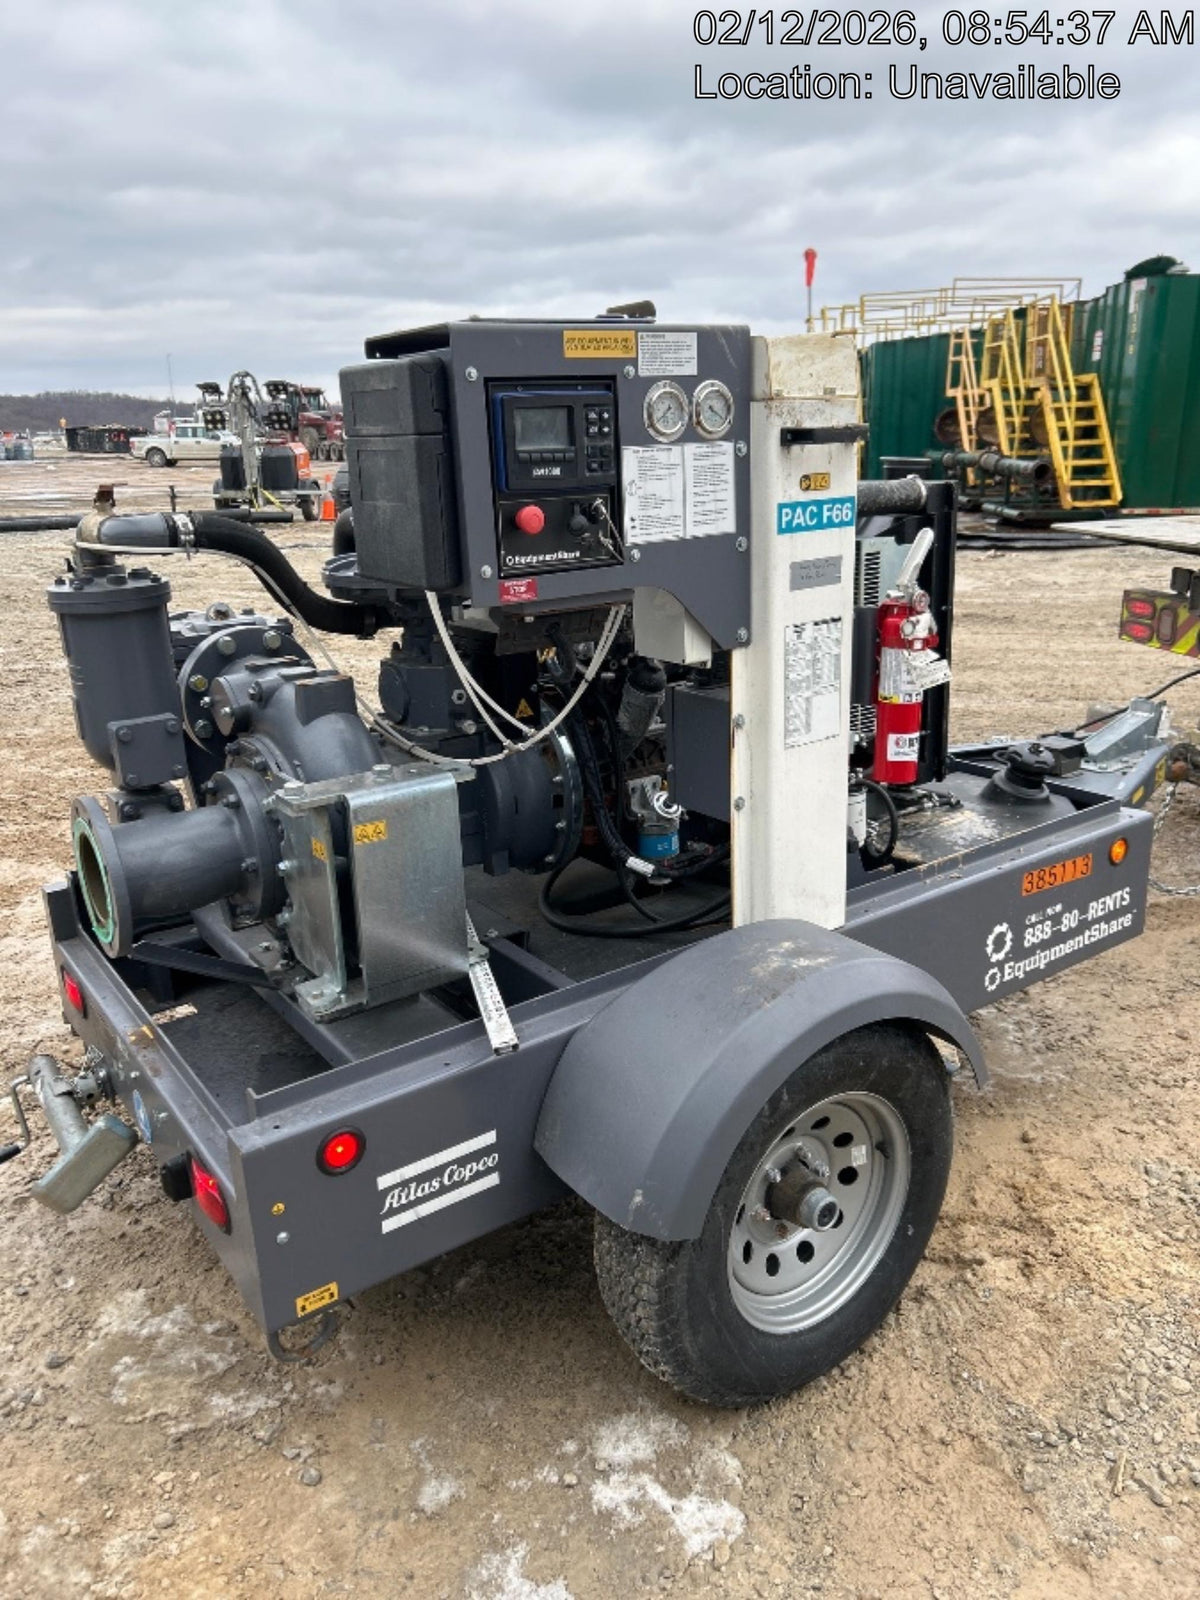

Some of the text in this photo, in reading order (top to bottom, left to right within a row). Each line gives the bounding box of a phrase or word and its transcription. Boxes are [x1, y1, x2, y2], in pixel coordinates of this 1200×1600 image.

[781, 502, 853, 529] PAC F66
[1002, 911, 1133, 982] EquipmentShare
[380, 1152, 499, 1215] Atlas Copco
